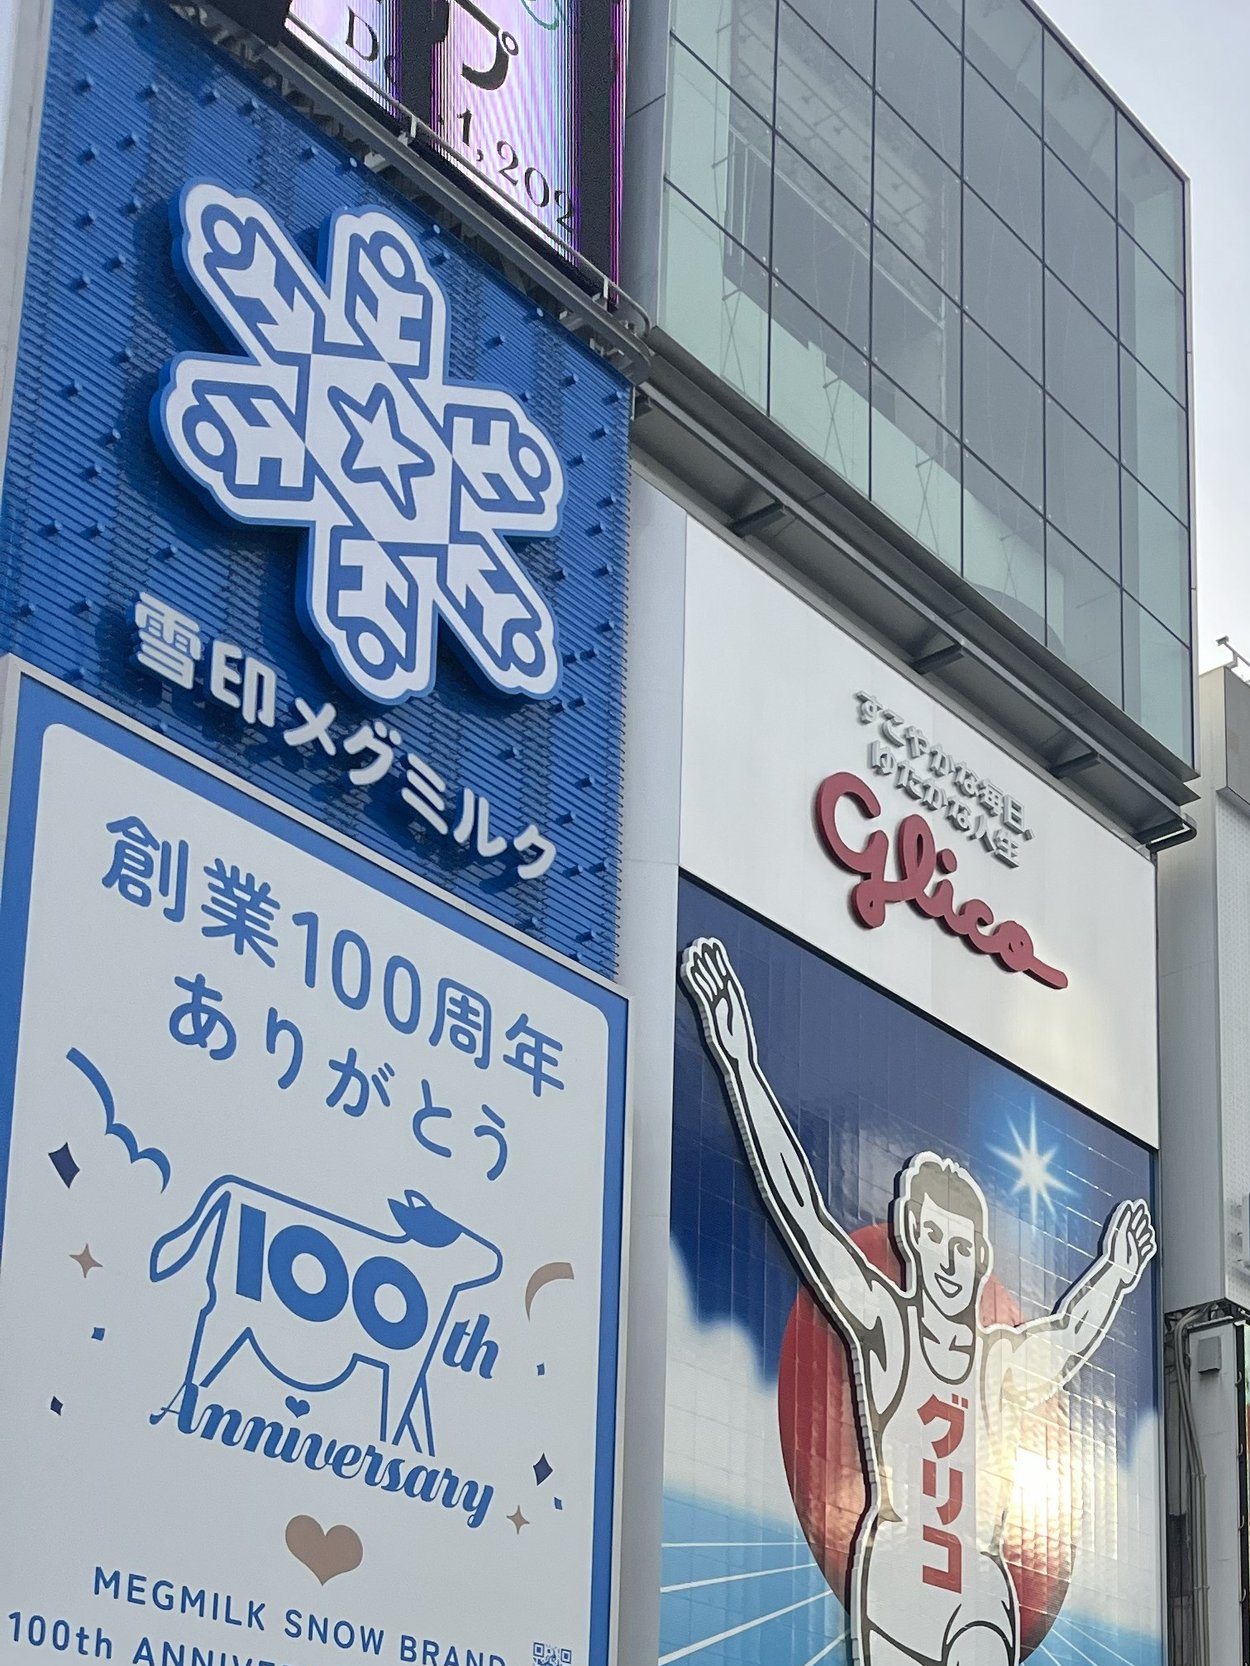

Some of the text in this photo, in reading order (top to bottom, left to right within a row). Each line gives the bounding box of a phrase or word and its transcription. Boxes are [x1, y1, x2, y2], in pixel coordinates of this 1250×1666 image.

[133, 591, 557, 880] 雪印メグミルク
[867, 740, 1021, 869] ゆたかな人生
[101, 814, 566, 1098] 創業100周年
[815, 771, 1069, 990] Glico
[168, 972, 510, 1181] ありがとう
[236, 1202, 500, 1380] 100 th
[149, 1382, 494, 1529] Anniversary
[915, 1392, 969, 1595] グリコ
[8, 1610, 113, 1660] 100th
[93, 1565, 267, 1632] MEGMILK
[283, 1609, 384, 1656] SNOW
